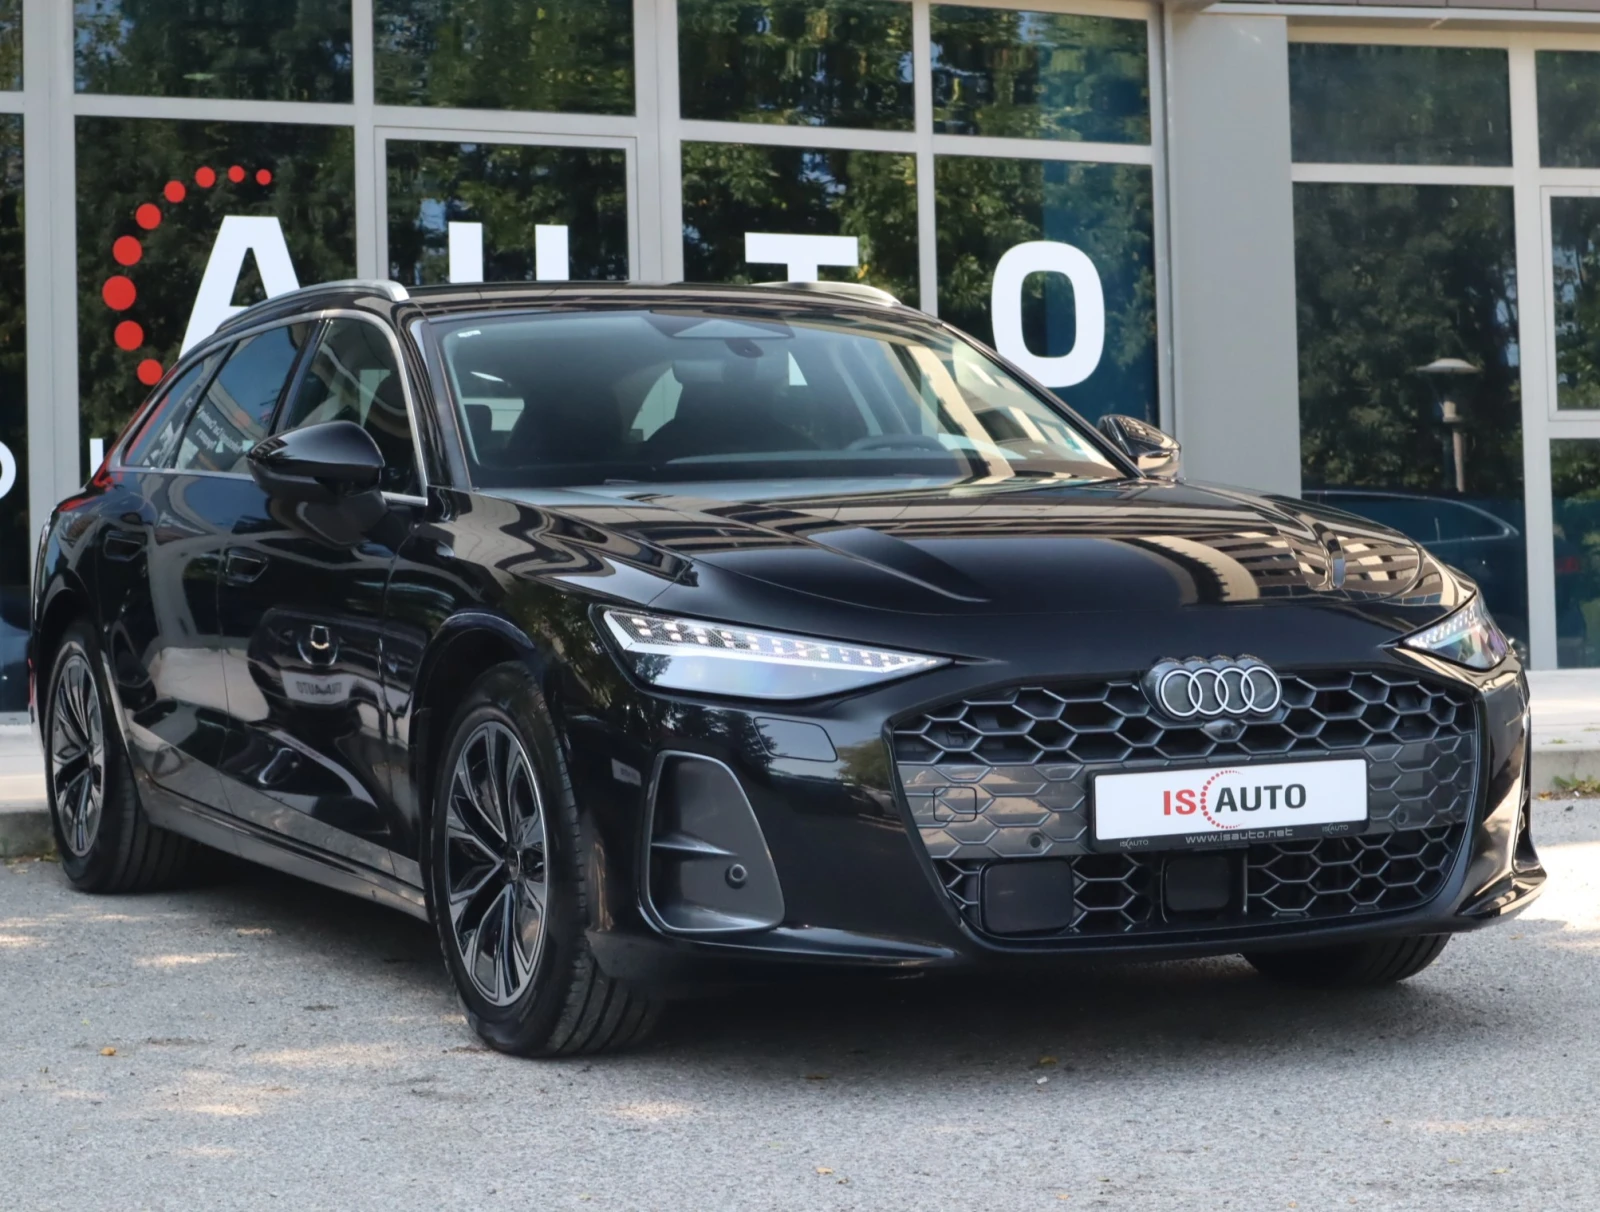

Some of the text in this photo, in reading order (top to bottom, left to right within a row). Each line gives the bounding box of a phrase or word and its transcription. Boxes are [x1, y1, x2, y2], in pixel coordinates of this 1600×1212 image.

[1163, 783, 1307, 815] IS AUTO
[1185, 827, 1294, 844] www.isauto.net
